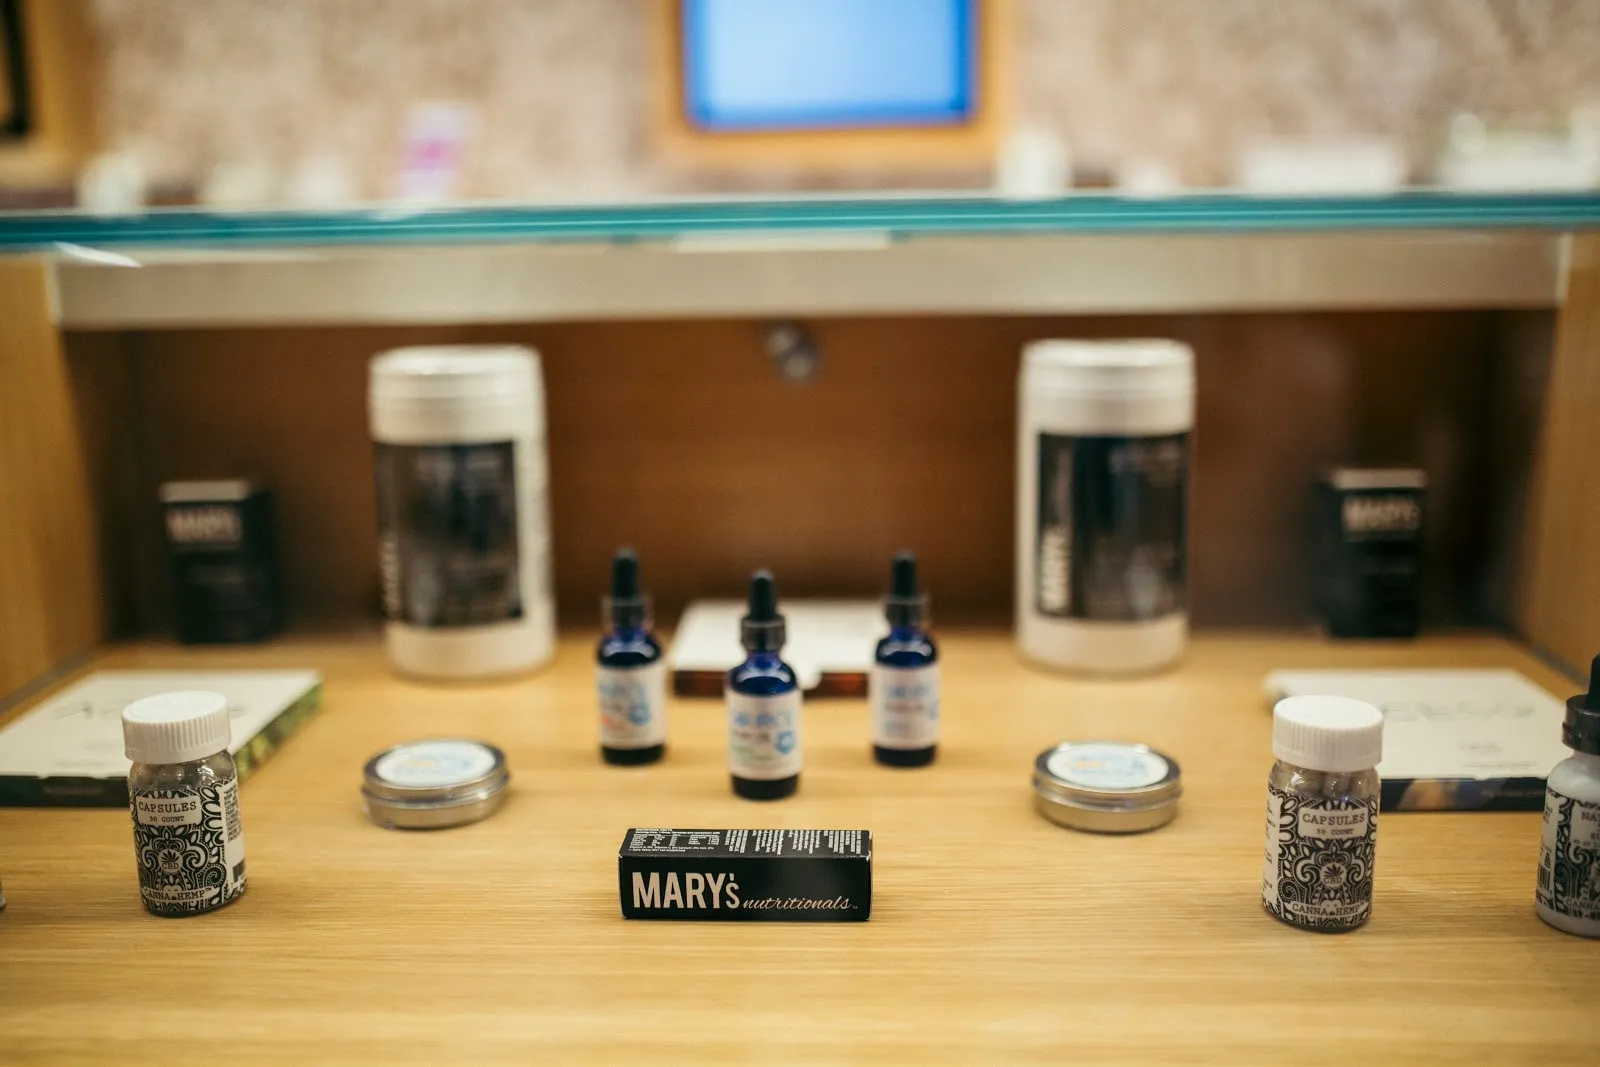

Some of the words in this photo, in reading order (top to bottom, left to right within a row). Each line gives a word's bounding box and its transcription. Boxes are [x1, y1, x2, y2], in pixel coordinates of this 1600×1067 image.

[138, 801, 197, 813] CAPSULES
[161, 815, 185, 823] COUNT
[1302, 813, 1365, 825] CAPSULES
[161, 862, 179, 870] CBD
[143, 887, 169, 900] CANNA
[177, 890, 206, 900] HEMP
[742, 896, 852, 911] nutritionals
[1292, 903, 1328, 916] CANNA
[1335, 905, 1360, 916] HEMP
